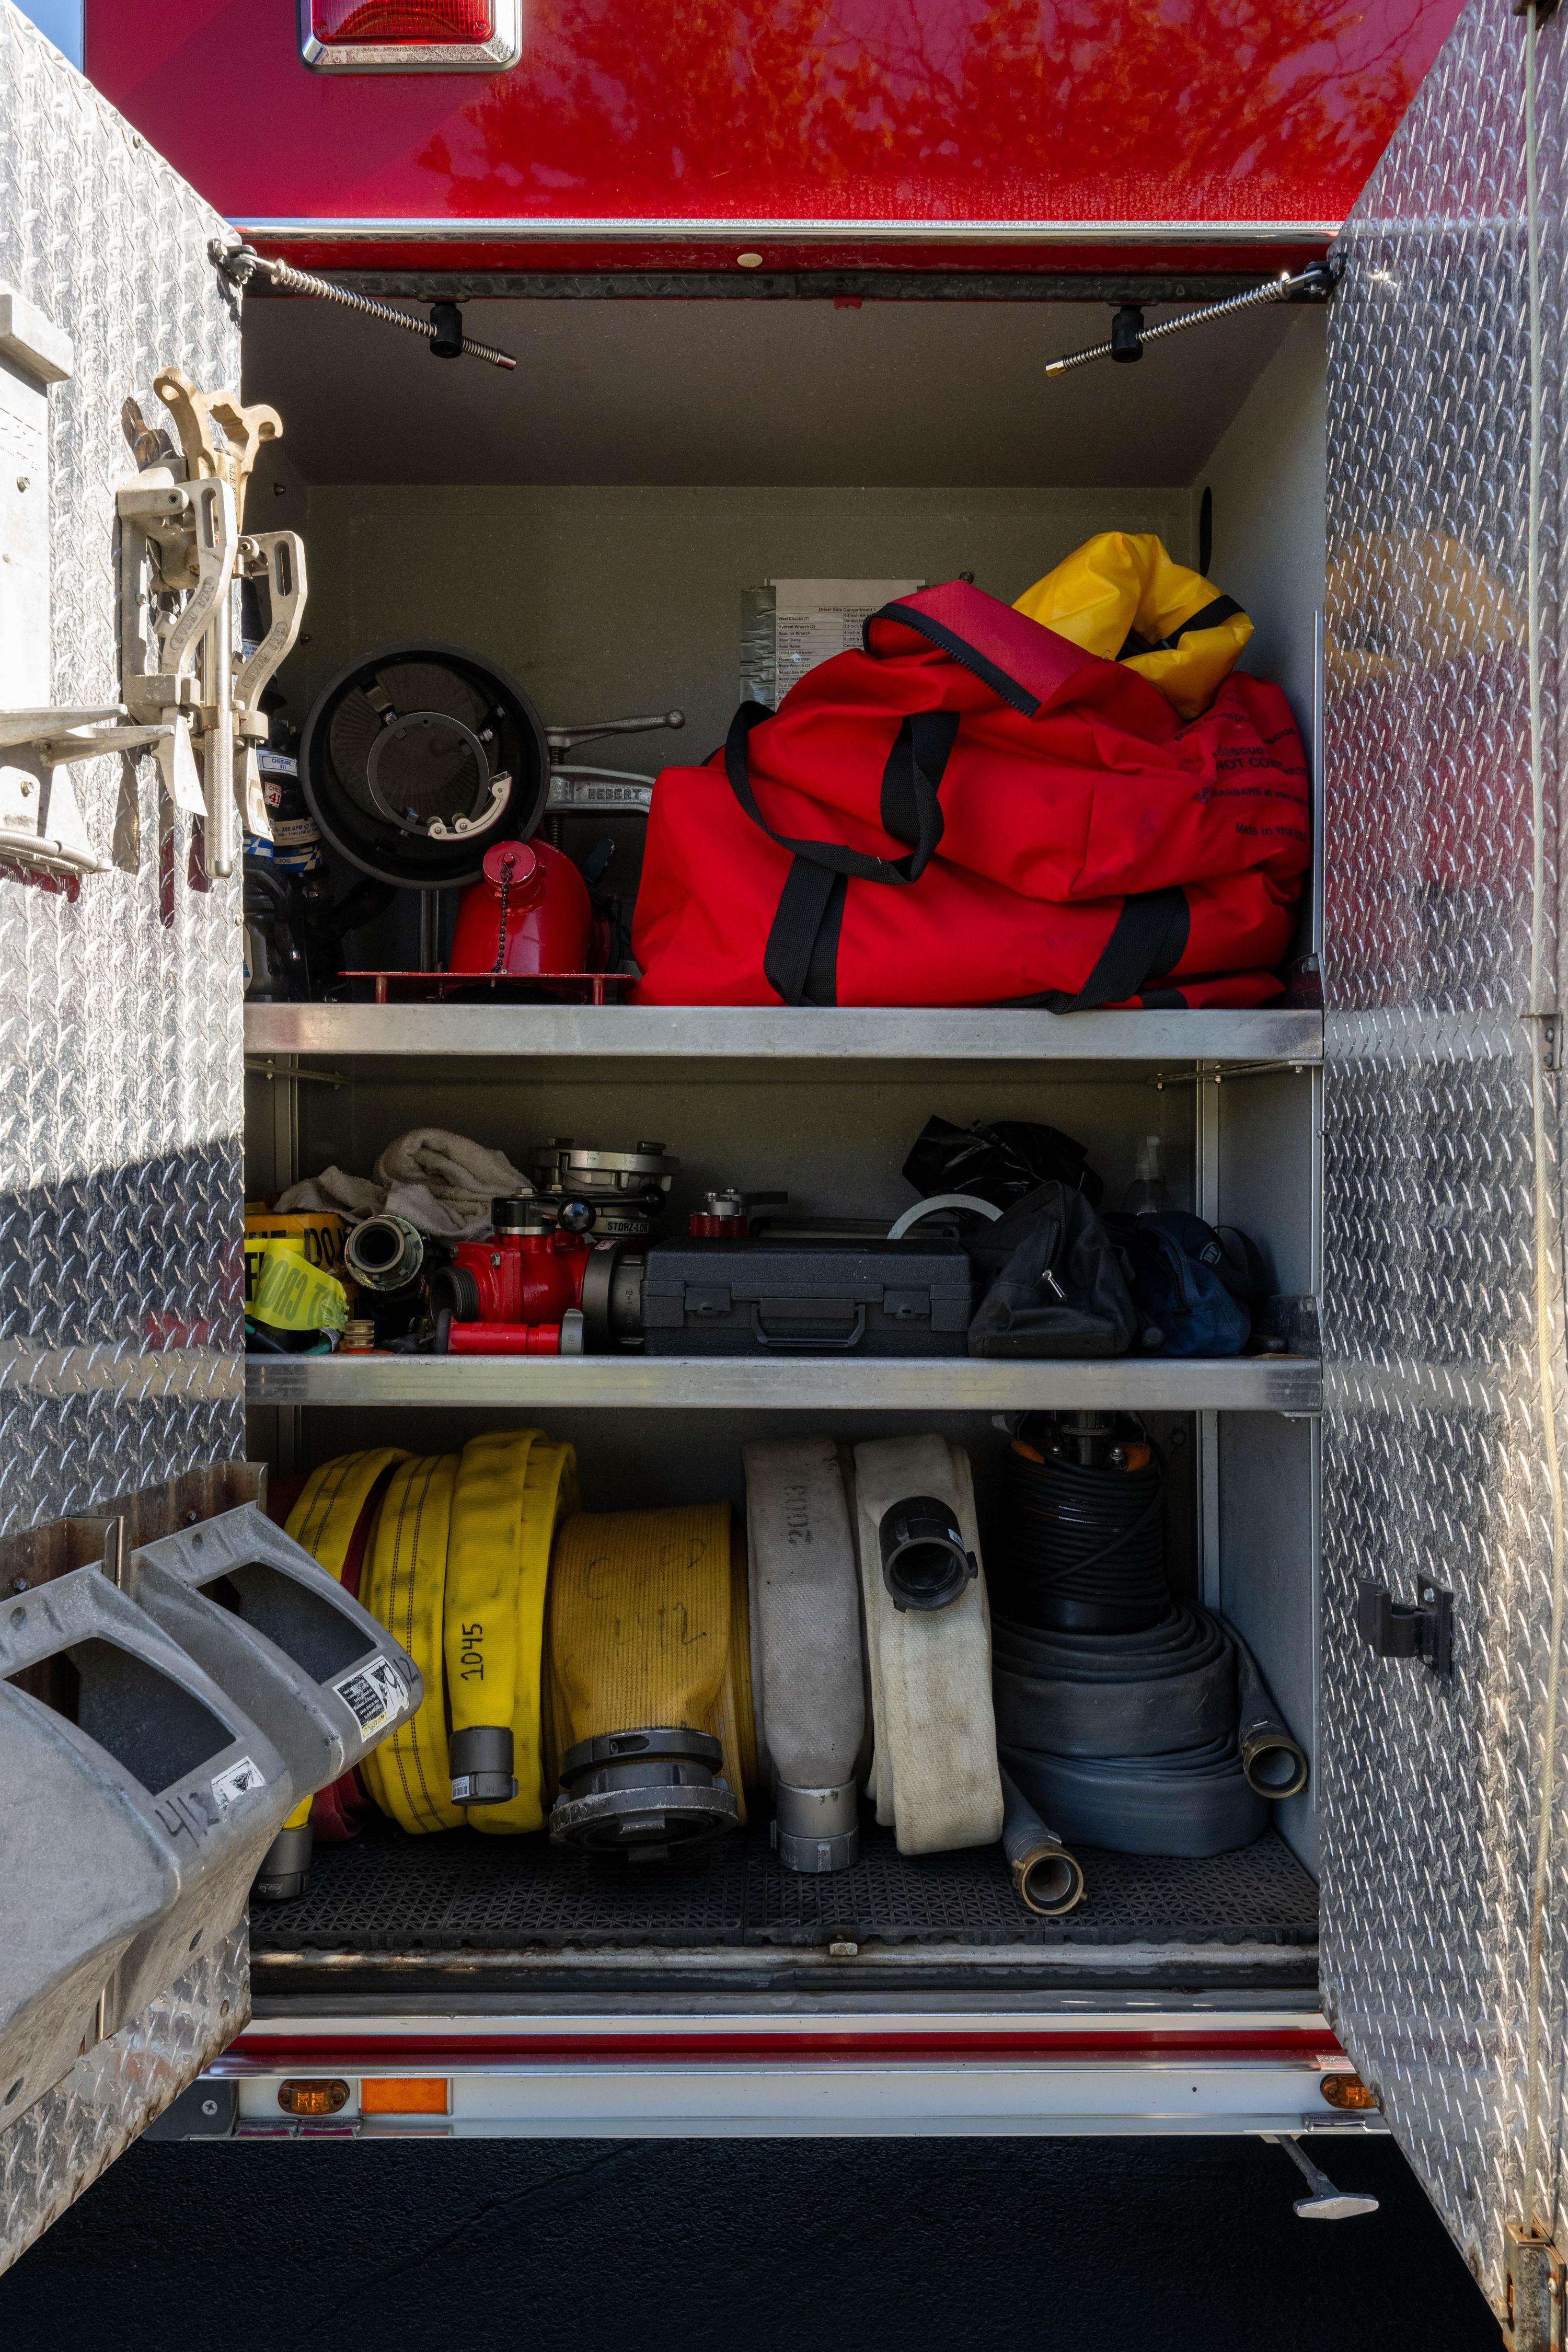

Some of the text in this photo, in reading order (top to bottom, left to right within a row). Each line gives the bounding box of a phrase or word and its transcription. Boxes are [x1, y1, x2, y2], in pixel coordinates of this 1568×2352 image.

[271, 758, 292, 766] CHESHIRE
[589, 788, 642, 800] HEBERT
[607, 1221, 649, 1232] STORZ-LOK
[461, 1623, 484, 1680] 1045
[154, 1792, 220, 1848] 412
